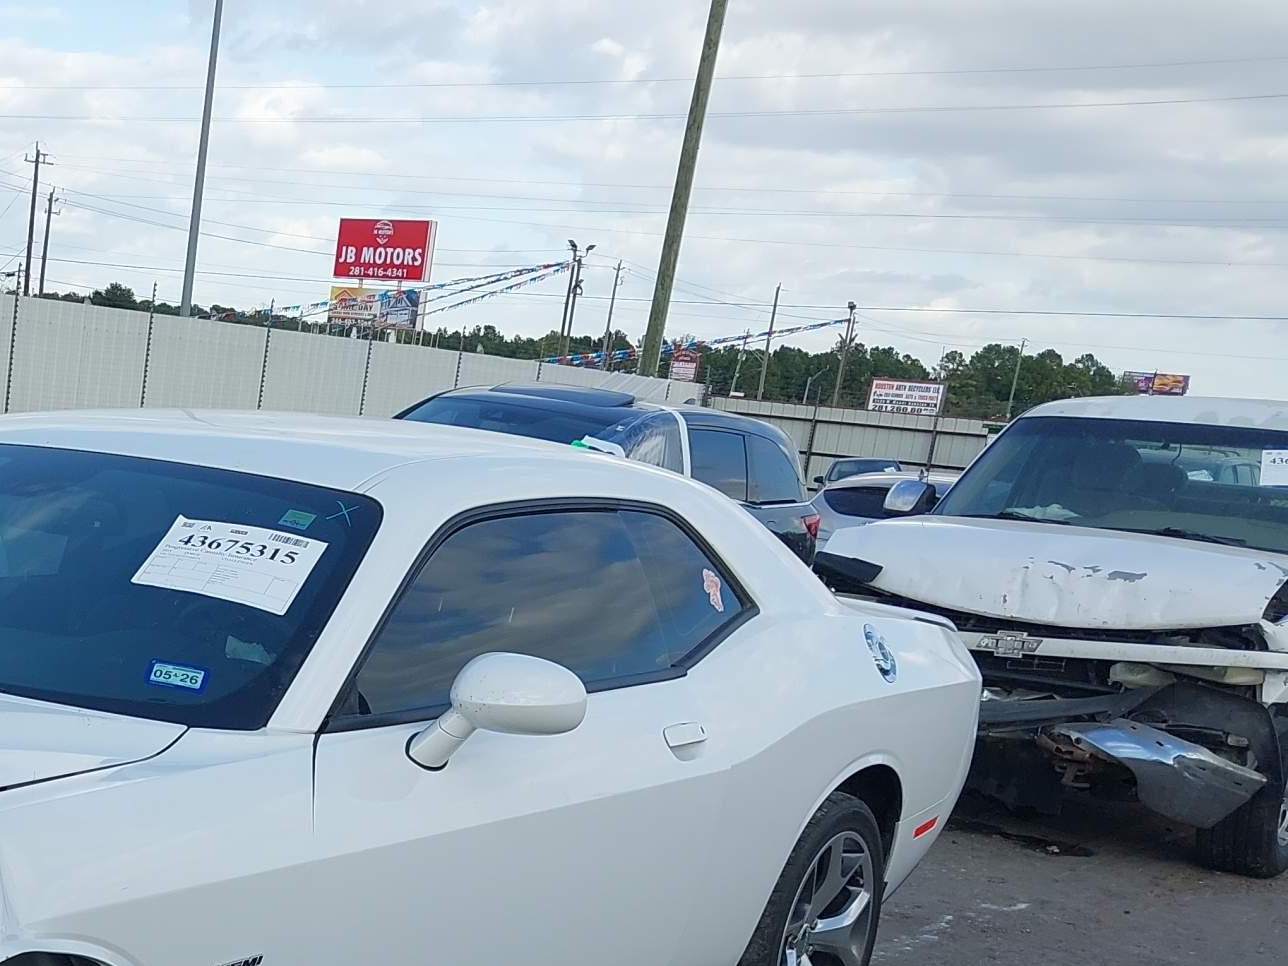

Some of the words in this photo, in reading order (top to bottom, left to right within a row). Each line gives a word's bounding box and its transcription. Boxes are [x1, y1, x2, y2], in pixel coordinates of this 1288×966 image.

[339, 246, 356, 264] JB
[361, 247, 422, 266] MOTORS
[349, 266, 408, 278] 281-416-4341
[179, 533, 299, 564] 43675315
[153, 669, 173, 680] 05
[179, 673, 200, 685] 26
